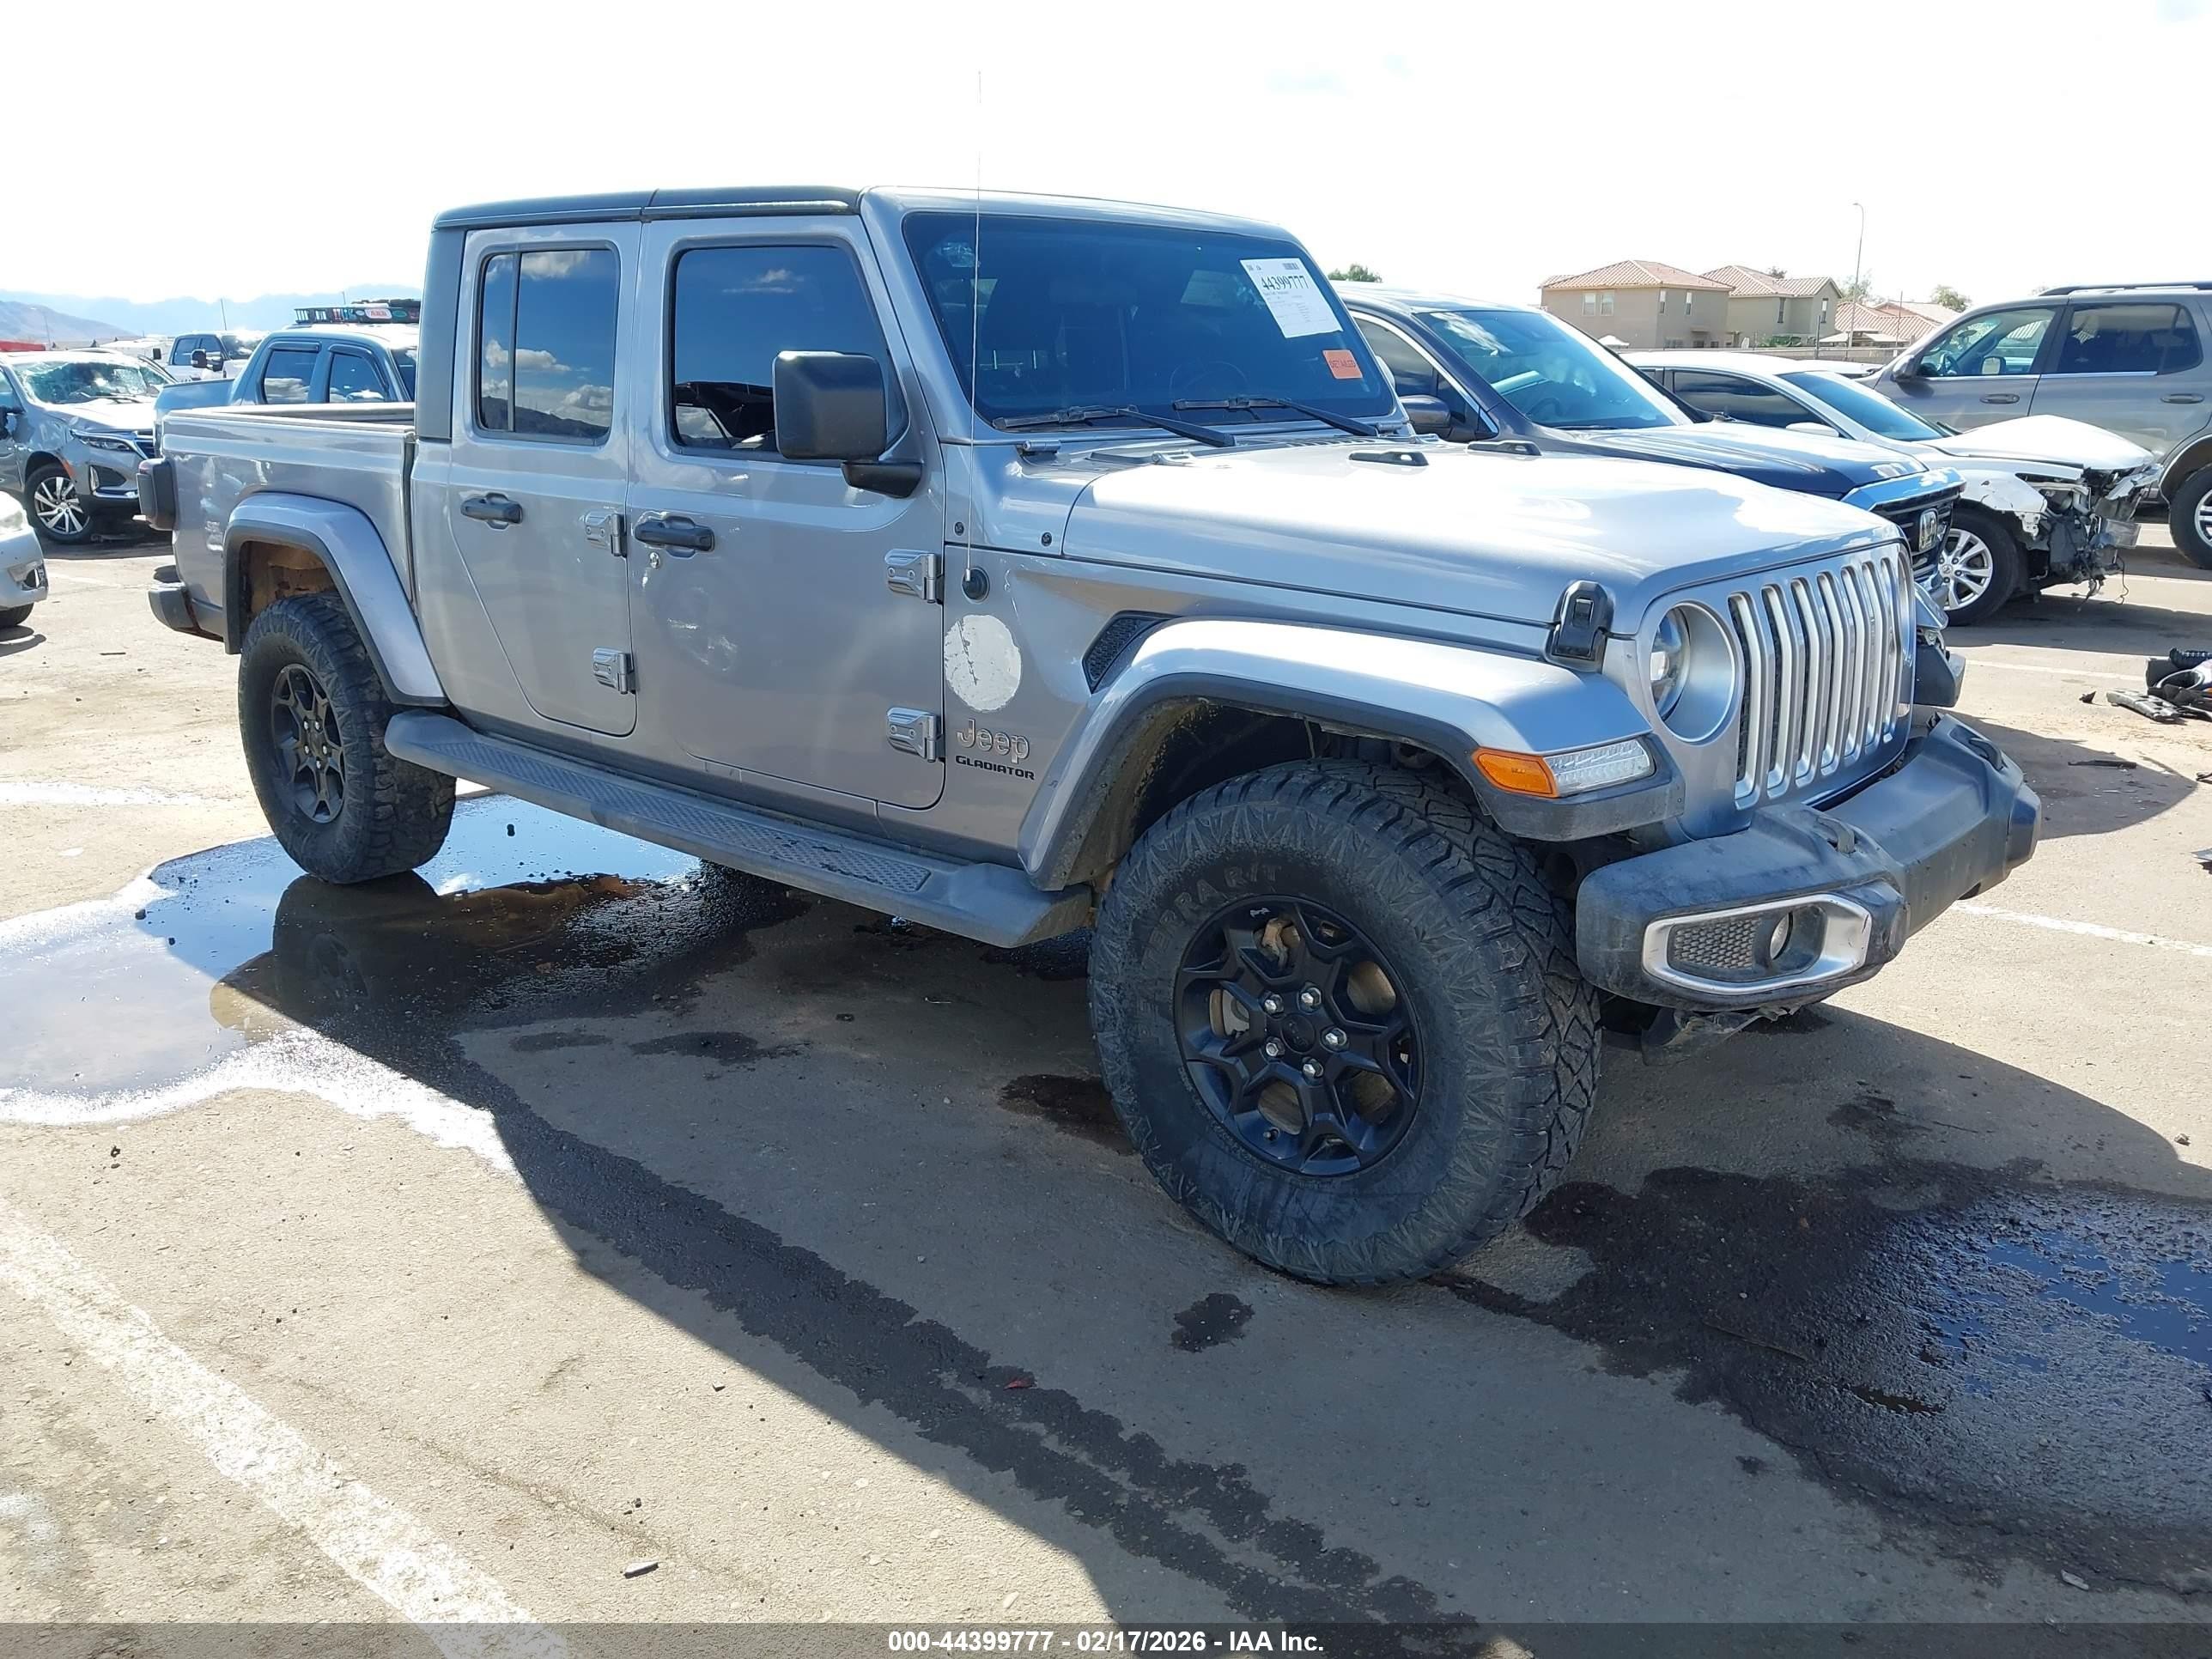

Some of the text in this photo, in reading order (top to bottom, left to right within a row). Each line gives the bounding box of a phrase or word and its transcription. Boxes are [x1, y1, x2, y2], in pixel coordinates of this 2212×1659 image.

[1261, 275, 1310, 290] 44399777
[956, 718, 1030, 764] Jeep
[956, 755, 1035, 780] GLADIATOR
